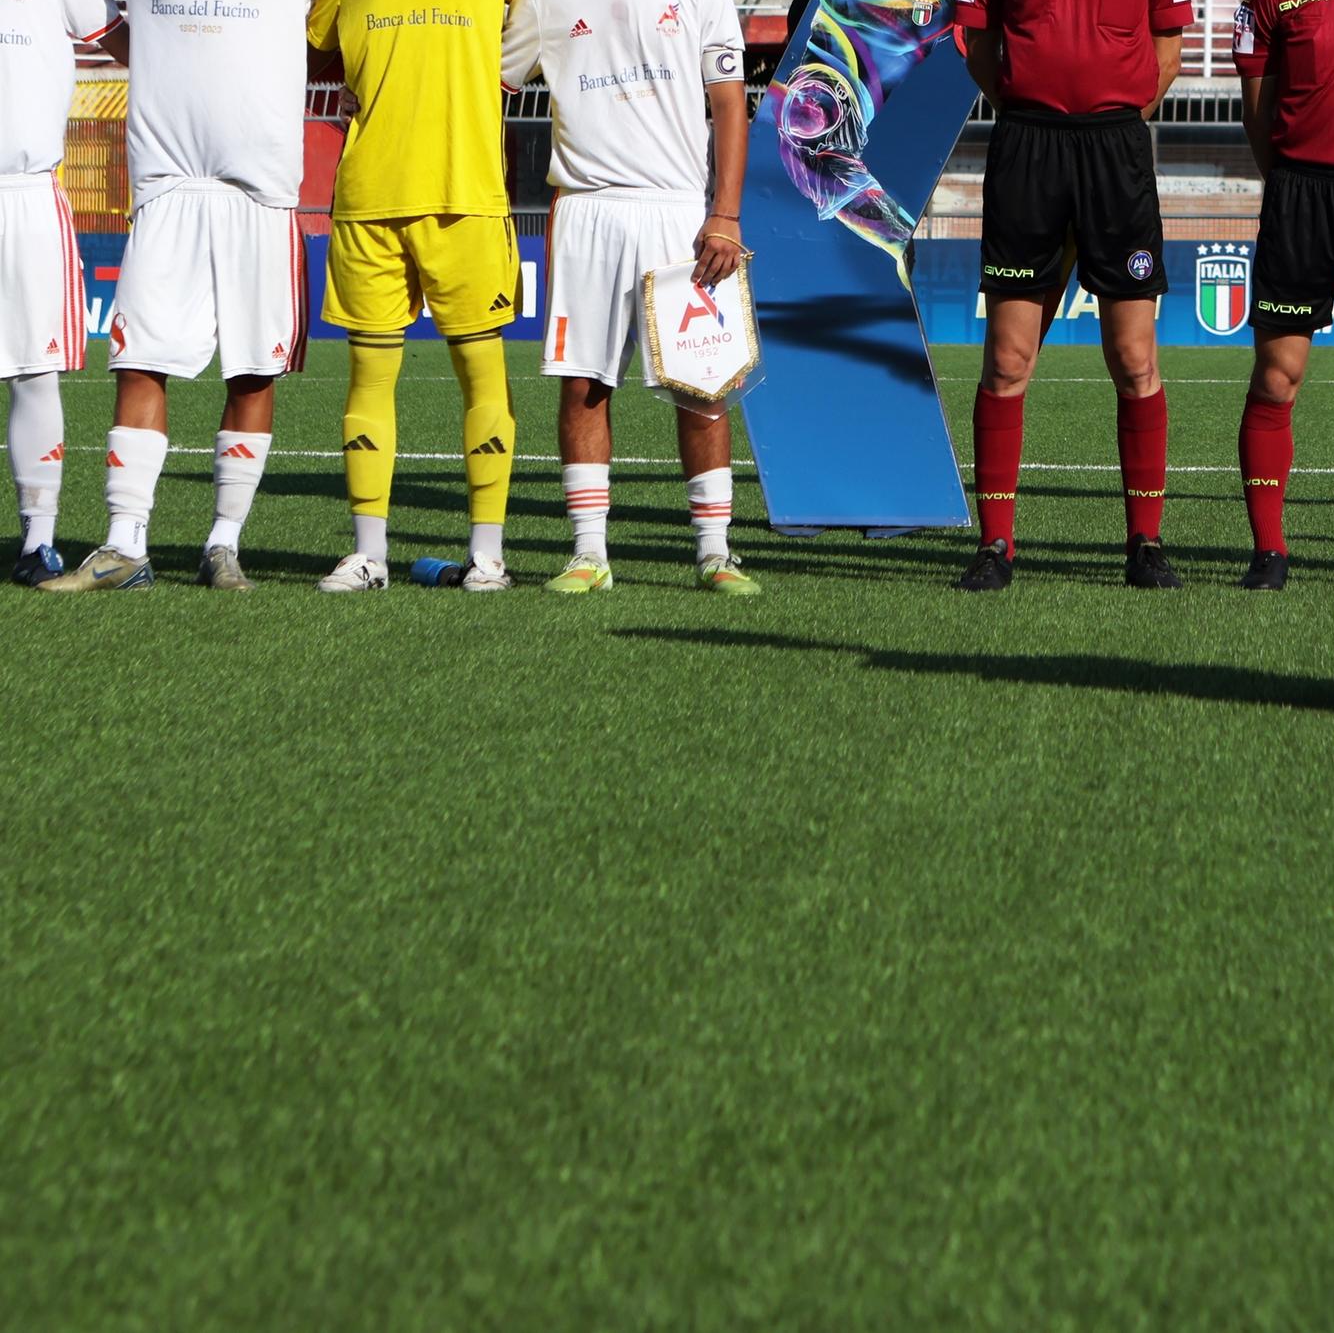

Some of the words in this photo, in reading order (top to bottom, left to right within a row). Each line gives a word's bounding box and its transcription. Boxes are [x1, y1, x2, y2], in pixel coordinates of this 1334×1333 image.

[188, 0, 208, 16] del
[214, 0, 260, 19] Fucino
[366, 13, 404, 31] Banca
[407, 9, 426, 26] del
[431, 7, 472, 28] Fucino
[569, 29, 593, 39] adidas
[716, 52, 736, 75] C
[578, 74, 618, 92] Banca
[620, 66, 638, 83] del
[984, 264, 1034, 278] GIVOVA
[1133, 258, 1150, 269] AIA
[1200, 263, 1245, 279] ITALIA
[1258, 300, 1312, 315] GIVOVA
[676, 332, 733, 351] MILANO
[693, 348, 720, 358] 1952
